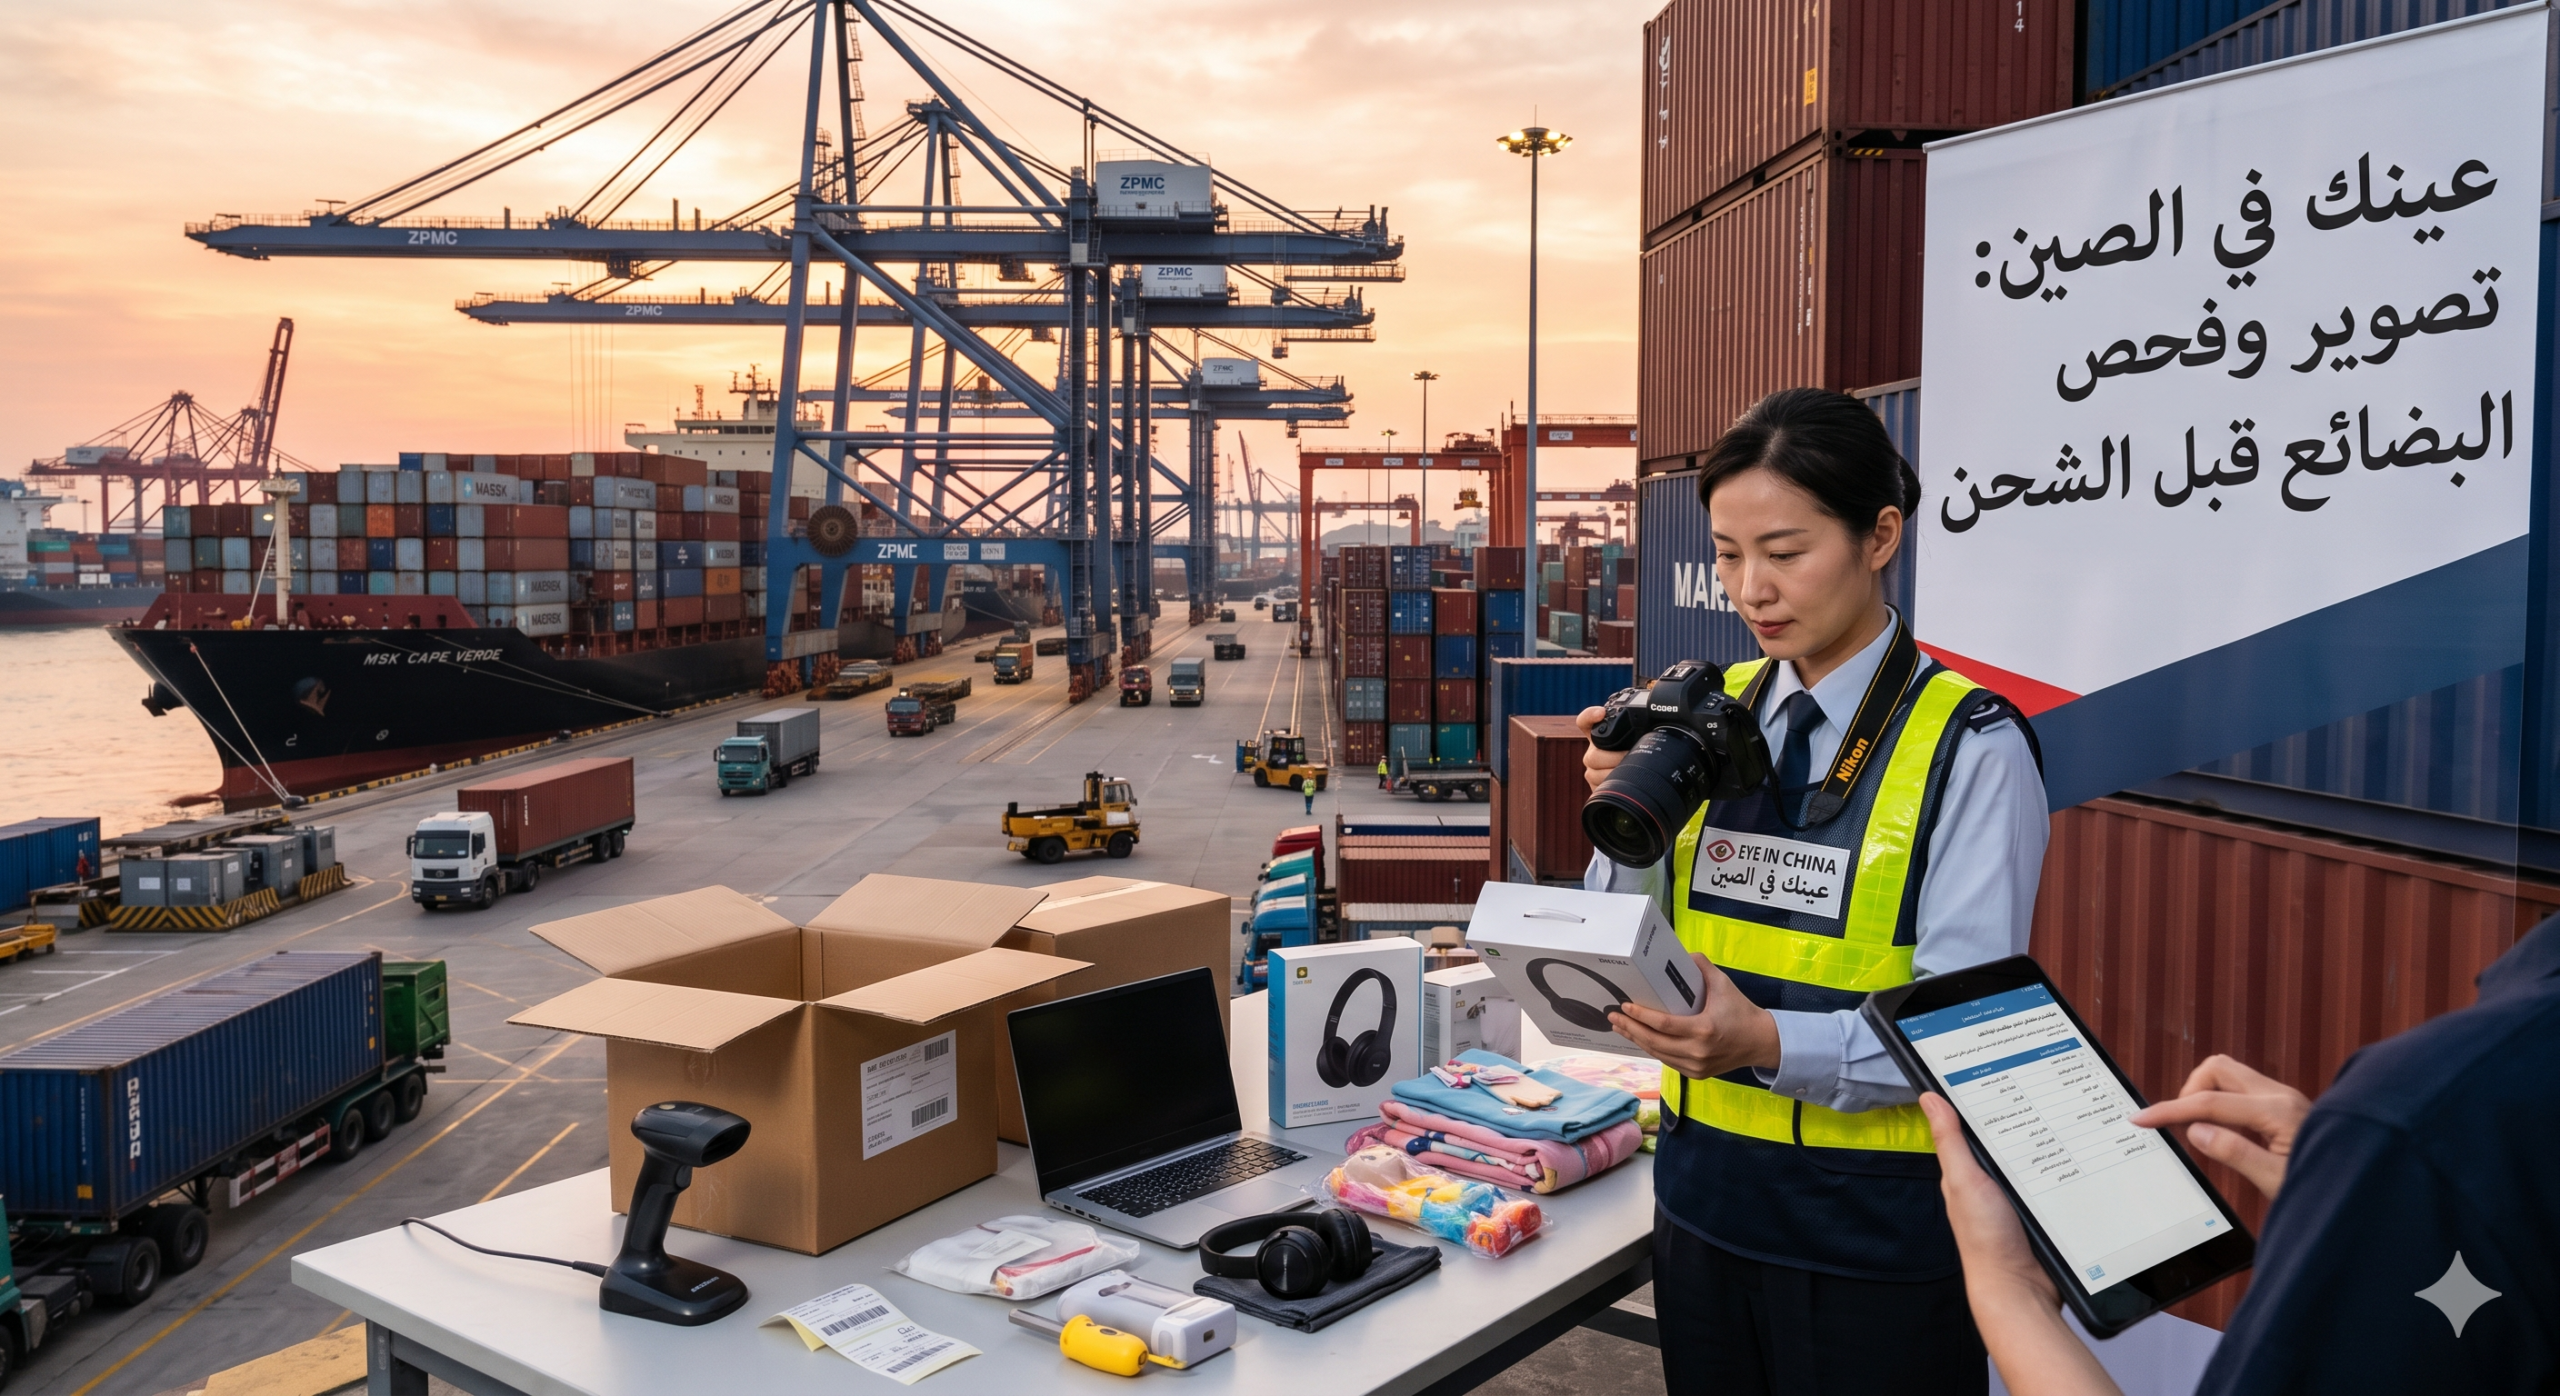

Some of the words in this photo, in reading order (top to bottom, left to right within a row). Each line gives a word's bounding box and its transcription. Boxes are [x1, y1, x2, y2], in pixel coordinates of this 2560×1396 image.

[1120, 176, 1165, 190] ZPMC
[2306, 151, 2499, 246] عينك
[408, 230, 458, 246] ZPMC
[1974, 185, 2185, 304] الصين:
[2213, 168, 2276, 290] في
[1158, 267, 1193, 277] ZPMC
[625, 305, 663, 316] ZPMC
[2290, 266, 2503, 375] تصوير
[2055, 297, 2268, 404] وفحص
[2154, 418, 2261, 512] قبل
[2281, 389, 2514, 513] البضائع
[1940, 433, 2132, 535] الشحن
[877, 543, 918, 559] ZPMC
[1674, 562, 1737, 613] MAR
[363, 652, 401, 666] MSK
[407, 651, 451, 664] CAPE
[456, 648, 503, 662] VERDE
[1835, 737, 1870, 783] Nikon
[1711, 866, 1755, 889] الصين
[1737, 844, 1762, 862] EYE
[1763, 847, 1780, 865] IN
[1782, 851, 1837, 876] CHINA
[1759, 869, 1775, 900] في
[1781, 875, 1829, 905] عينك
